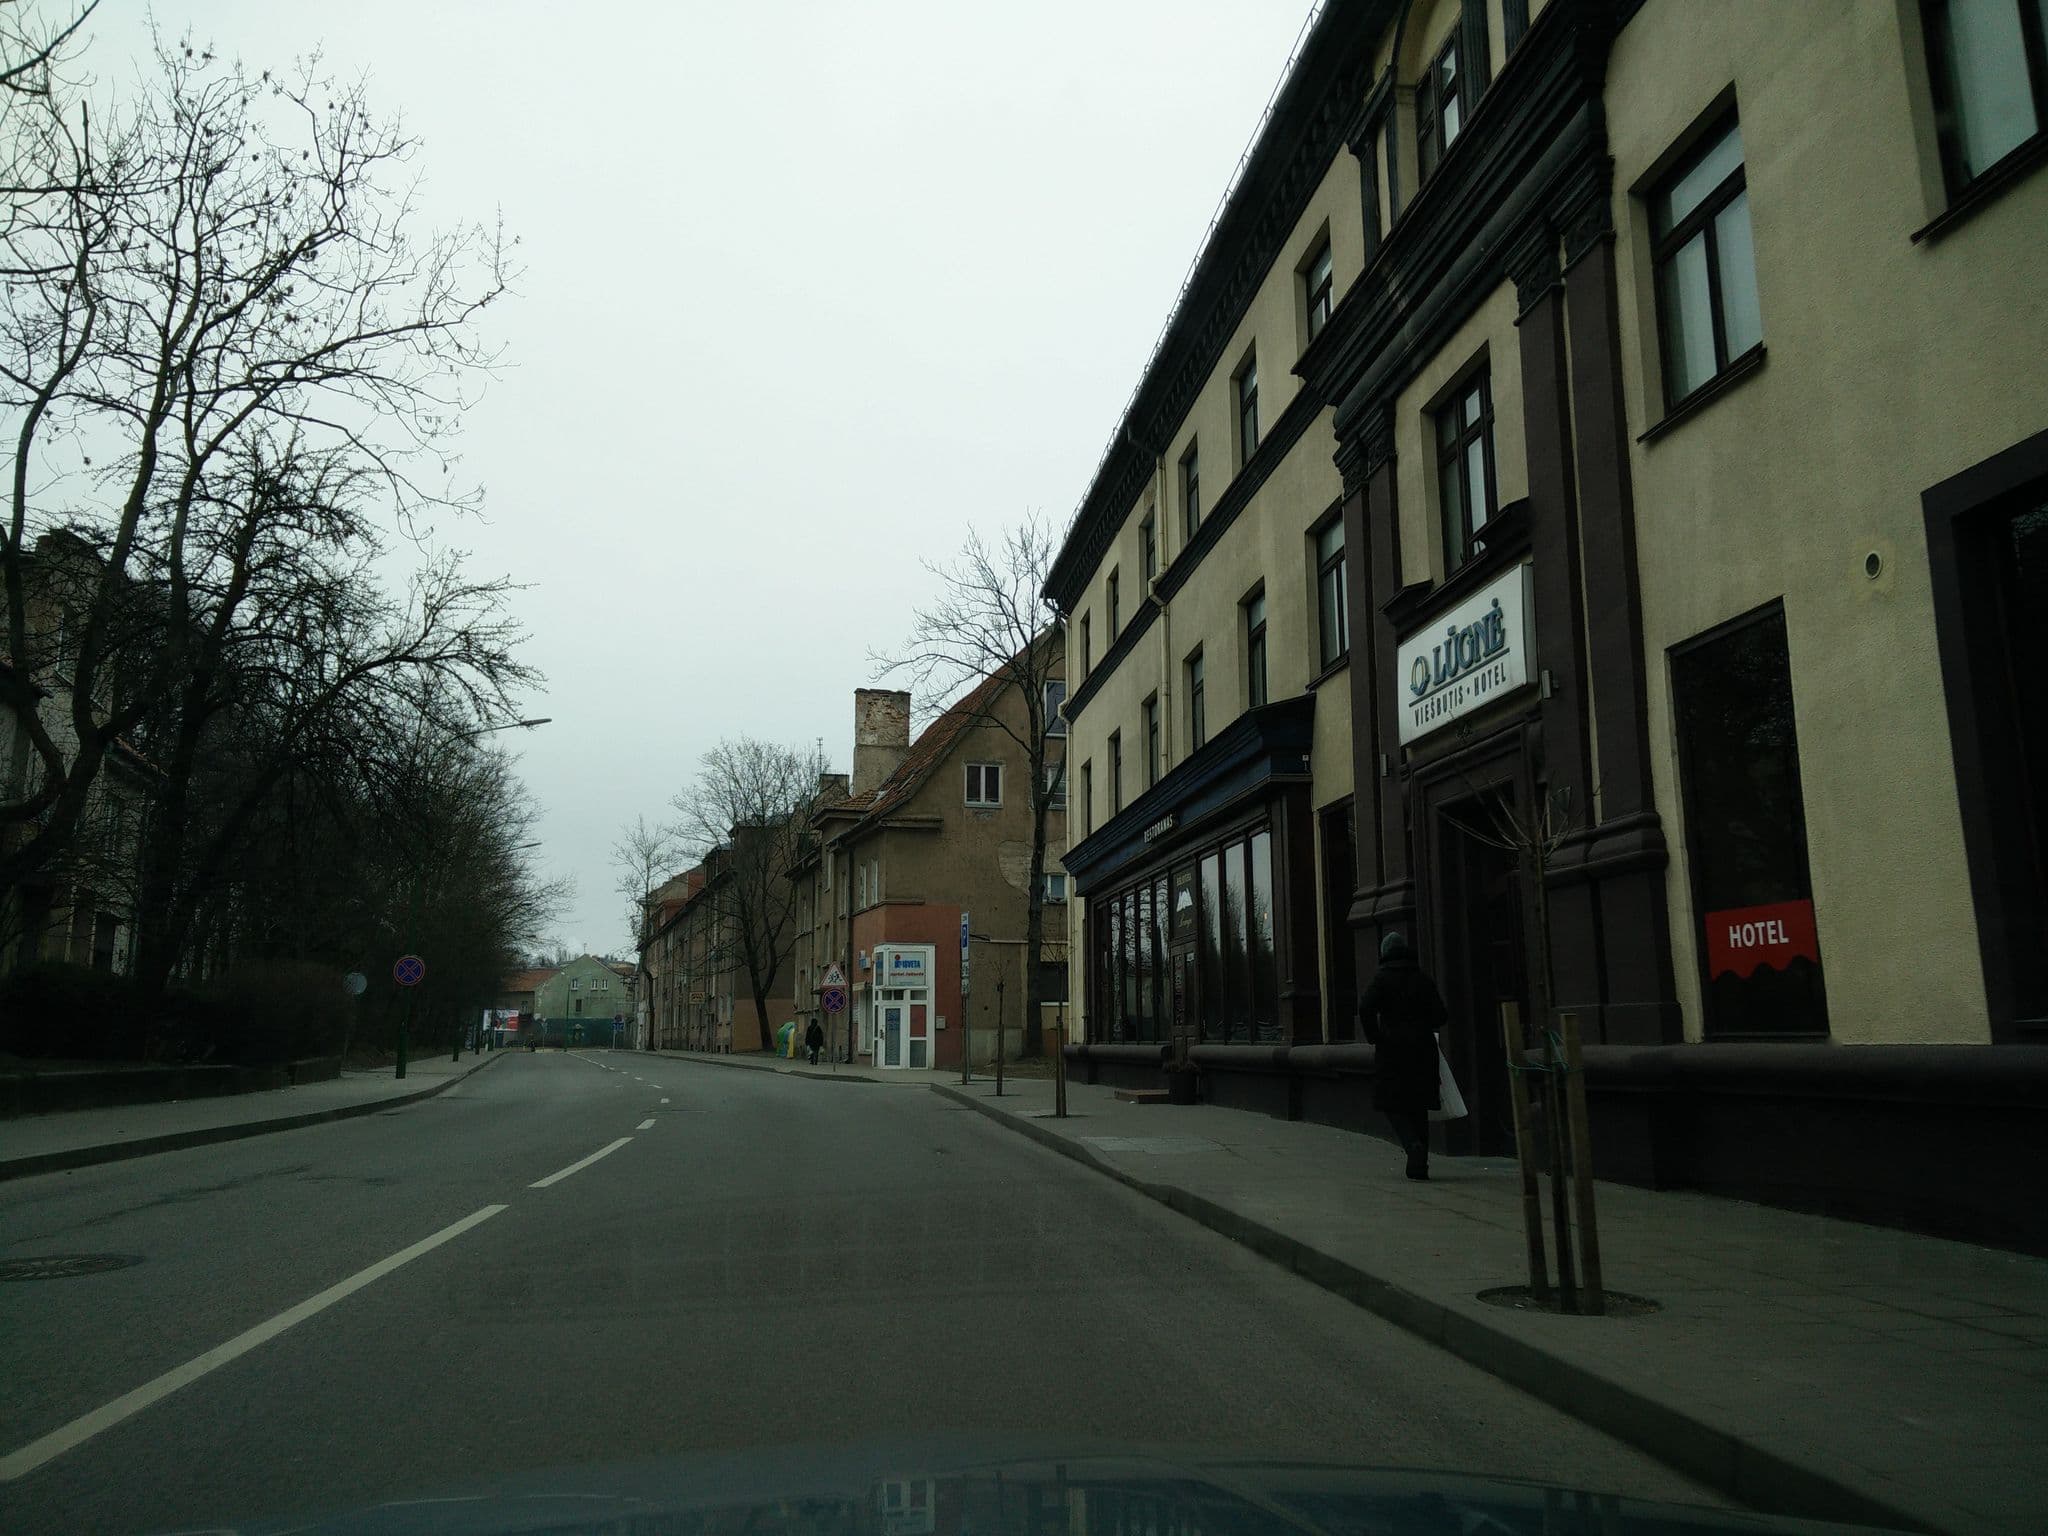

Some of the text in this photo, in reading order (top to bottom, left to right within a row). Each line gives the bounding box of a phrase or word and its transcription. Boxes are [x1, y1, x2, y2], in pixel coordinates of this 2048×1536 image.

[1414, 662, 1506, 727] VIEŠBUTIS HOTEL
[1728, 919, 1790, 948] HOTEL
